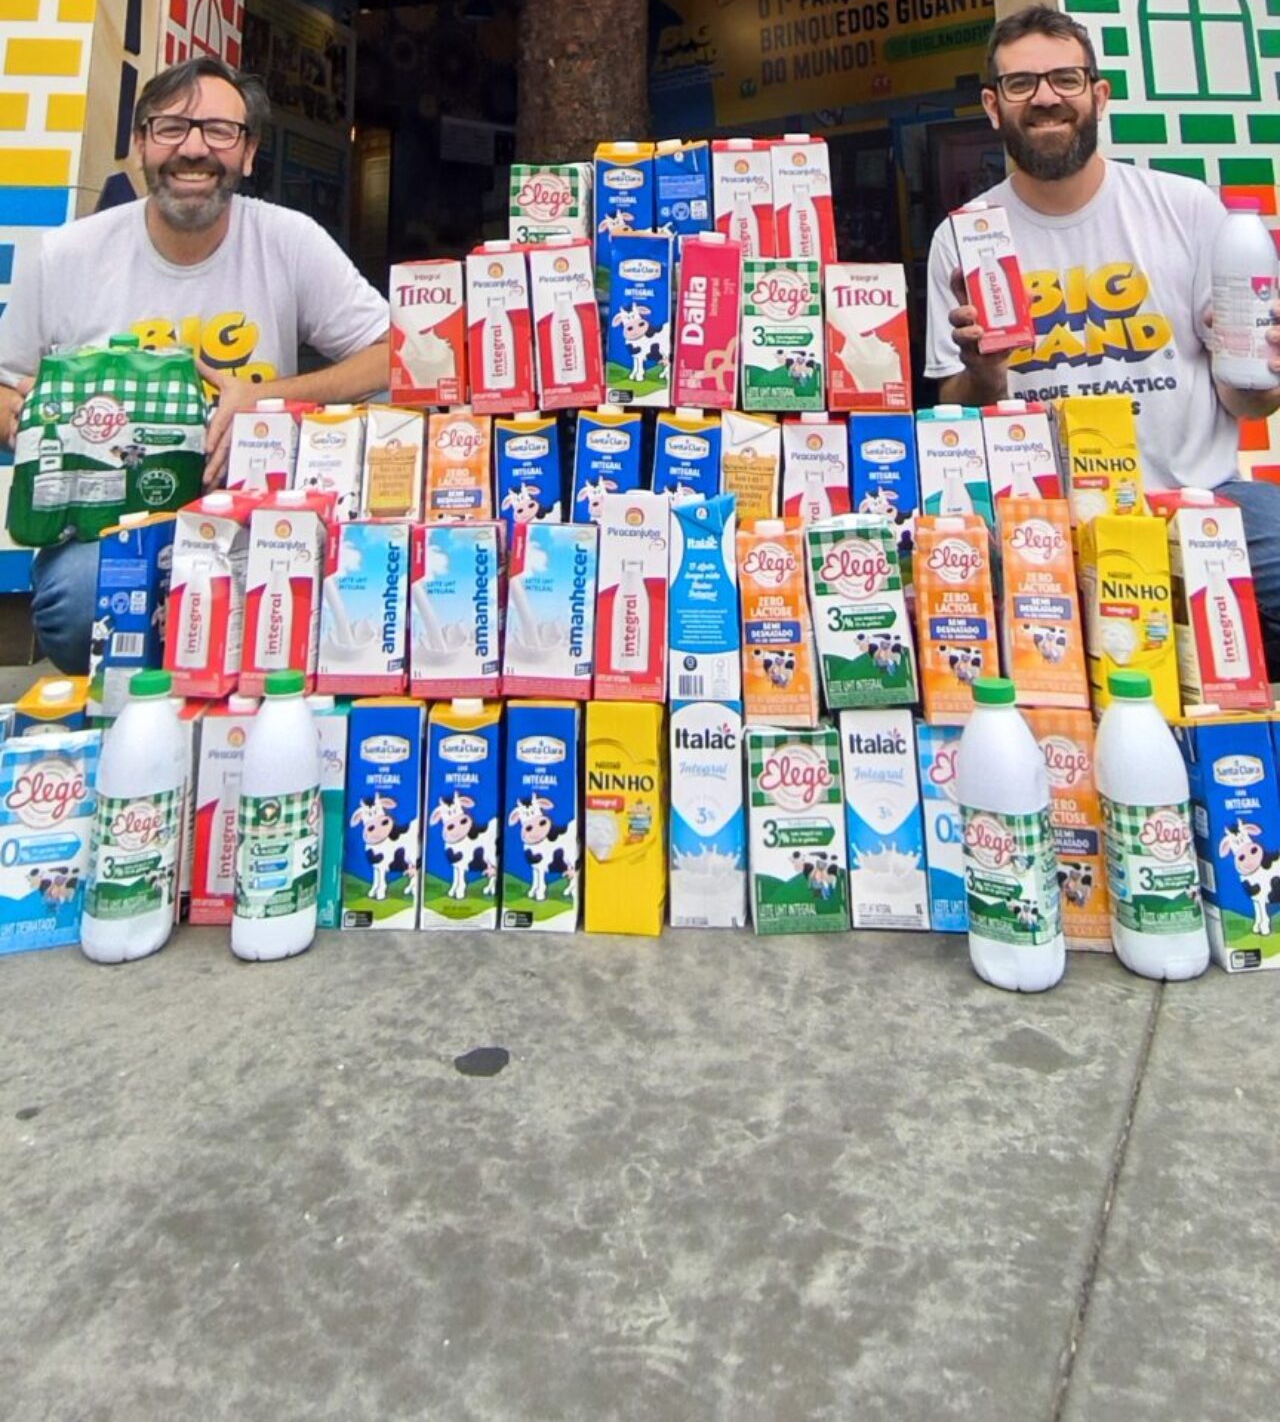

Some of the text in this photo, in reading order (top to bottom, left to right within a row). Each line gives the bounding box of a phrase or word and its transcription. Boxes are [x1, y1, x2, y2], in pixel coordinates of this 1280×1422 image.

[760, 3, 890, 52] BRINQUEDOS
[762, 58, 787, 87] DO
[793, 39, 878, 79] MUNDO!
[516, 182, 573, 218] Elegê
[396, 284, 457, 308] TIROL
[681, 275, 708, 347] Dália
[751, 279, 813, 317] Elegê
[833, 285, 900, 308] TIROL
[1023, 262, 1149, 330] BIG
[130, 311, 261, 369] BIG
[491, 325, 505, 378] integral
[559, 318, 574, 372] integral
[1077, 375, 1177, 397] TEMÁTICO
[70, 405, 128, 438] Elegê
[435, 429, 484, 457] Elegê
[1072, 456, 1137, 474] NINHO
[607, 528, 662, 540] Piracanjuba
[1009, 526, 1065, 560] Elegê
[743, 550, 798, 584] Elegê
[820, 549, 891, 592] Elegê
[927, 545, 983, 579] Elegê
[382, 541, 400, 654] amanhecer
[473, 543, 489, 657] amanhecer
[569, 543, 588, 658] amanhecer
[1102, 580, 1169, 601] NINHO
[186, 592, 201, 654] integral
[265, 592, 283, 656] integral
[621, 594, 640, 657] integral
[1214, 596, 1236, 663] integral
[675, 728, 736, 750] Italac
[849, 733, 907, 755] Italac
[588, 771, 655, 792] NINHO
[679, 761, 728, 777] Integral
[759, 755, 834, 804] Elegê
[1044, 743, 1091, 784] legê
[5, 772, 87, 820] Elegê
[1054, 799, 1078, 811] ERO
[111, 810, 163, 844] Elegê
[1052, 811, 1087, 825] CTOSE
[217, 808, 236, 879] integral
[965, 824, 1017, 864] Elegê
[1139, 820, 1191, 856] Elegê
